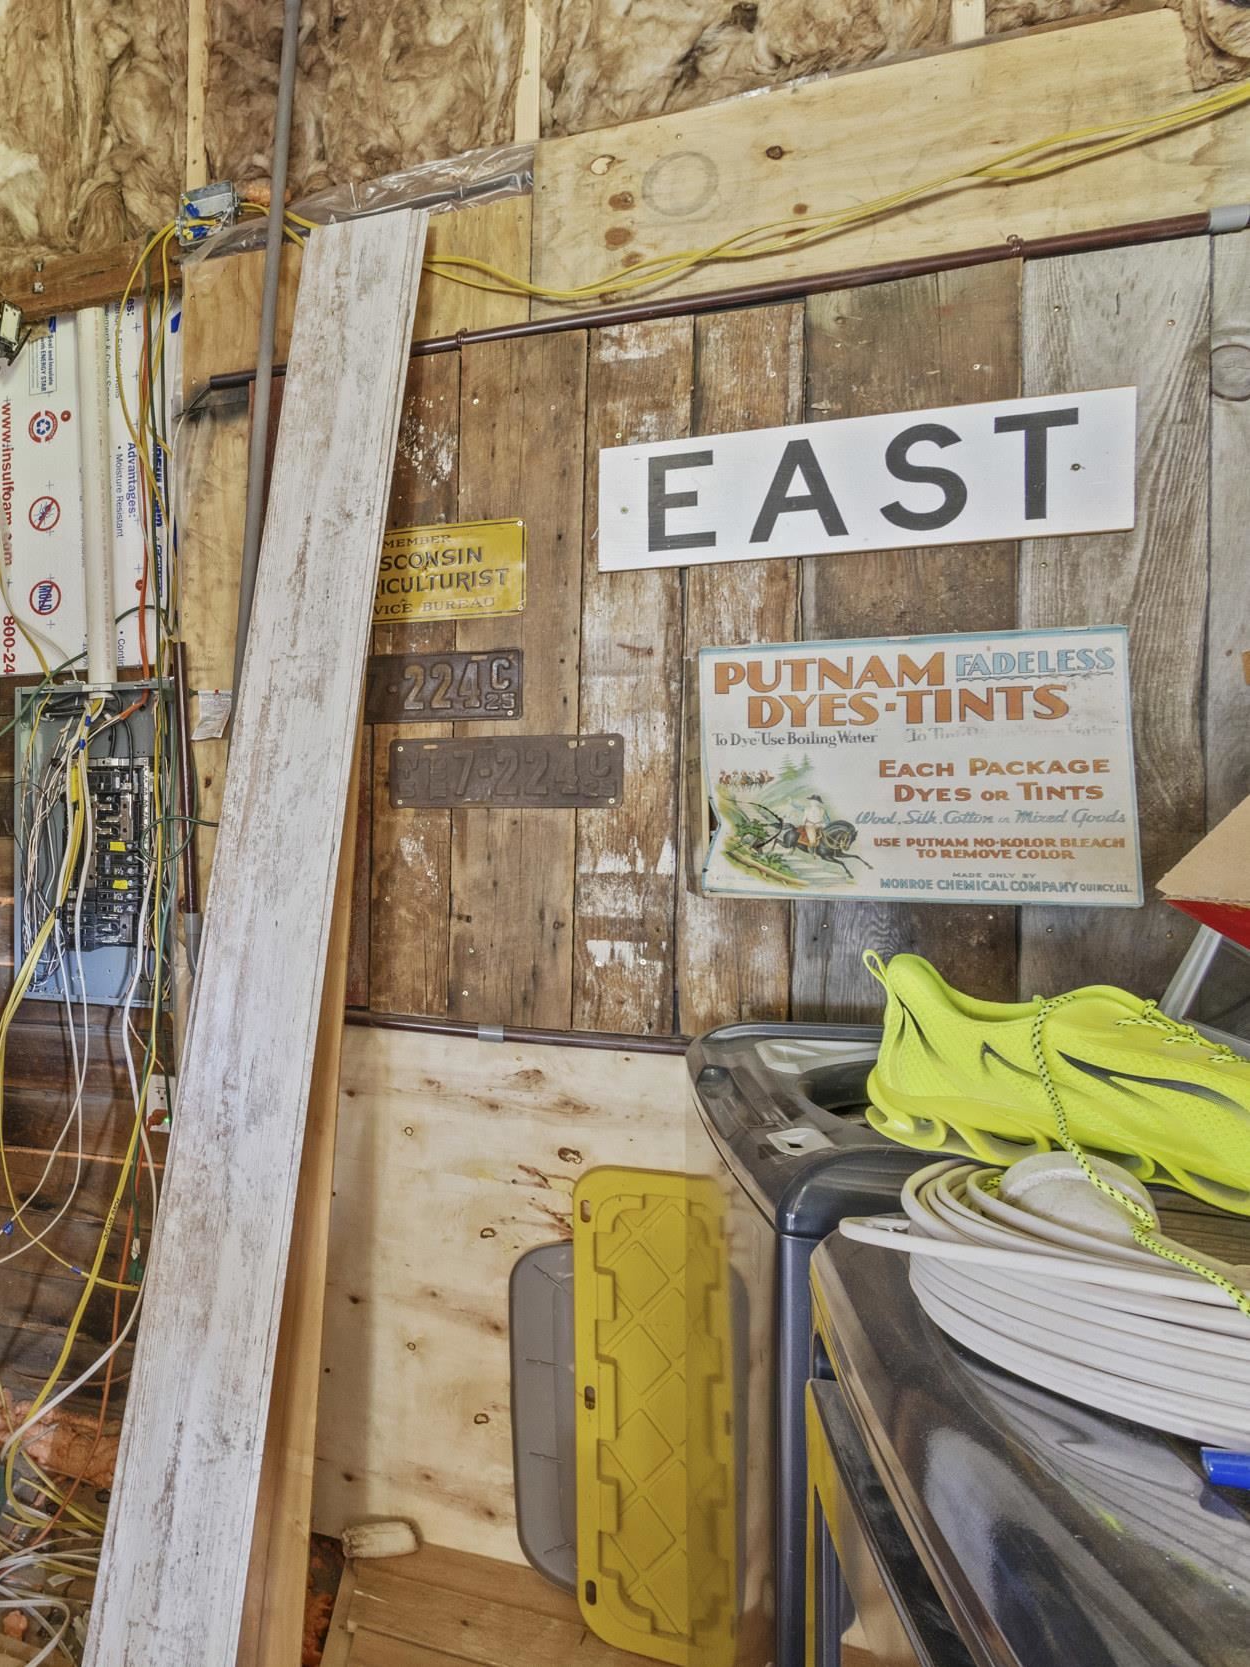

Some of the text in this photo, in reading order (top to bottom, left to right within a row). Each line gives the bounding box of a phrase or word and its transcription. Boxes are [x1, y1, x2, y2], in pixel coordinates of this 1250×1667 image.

[125, 443, 138, 519] Advantages:
[648, 407, 1080, 552] EAST
[116, 454, 125, 538] Moisture Resistant
[384, 535, 451, 549] MEMBER
[380, 547, 483, 572] SCONSIN
[375, 568, 510, 599] ICULTURIST
[37, 584, 53, 613] MOLD
[373, 597, 495, 616] VICE BUREAU
[714, 647, 1116, 694] PUTNAM FADELESS
[712, 732, 728, 746] To
[787, 729, 837, 750] Boiling
[879, 757, 1110, 778] EACH PACKAGE
[894, 783, 972, 803] DYES
[1015, 781, 1104, 801] TINTS
[943, 810, 994, 825] Cotton
[1014, 809, 1068, 825] Mixed
[1071, 808, 1126, 828] Goods
[873, 837, 1126, 849] USE PUTNAM NO-KOLOR BLEACH
[916, 849, 1076, 860] TO REMOVE COLOR
[879, 878, 933, 890] MONROE
[937, 878, 1008, 892] CHEMICAL
[1011, 880, 1080, 894] COMPANY
